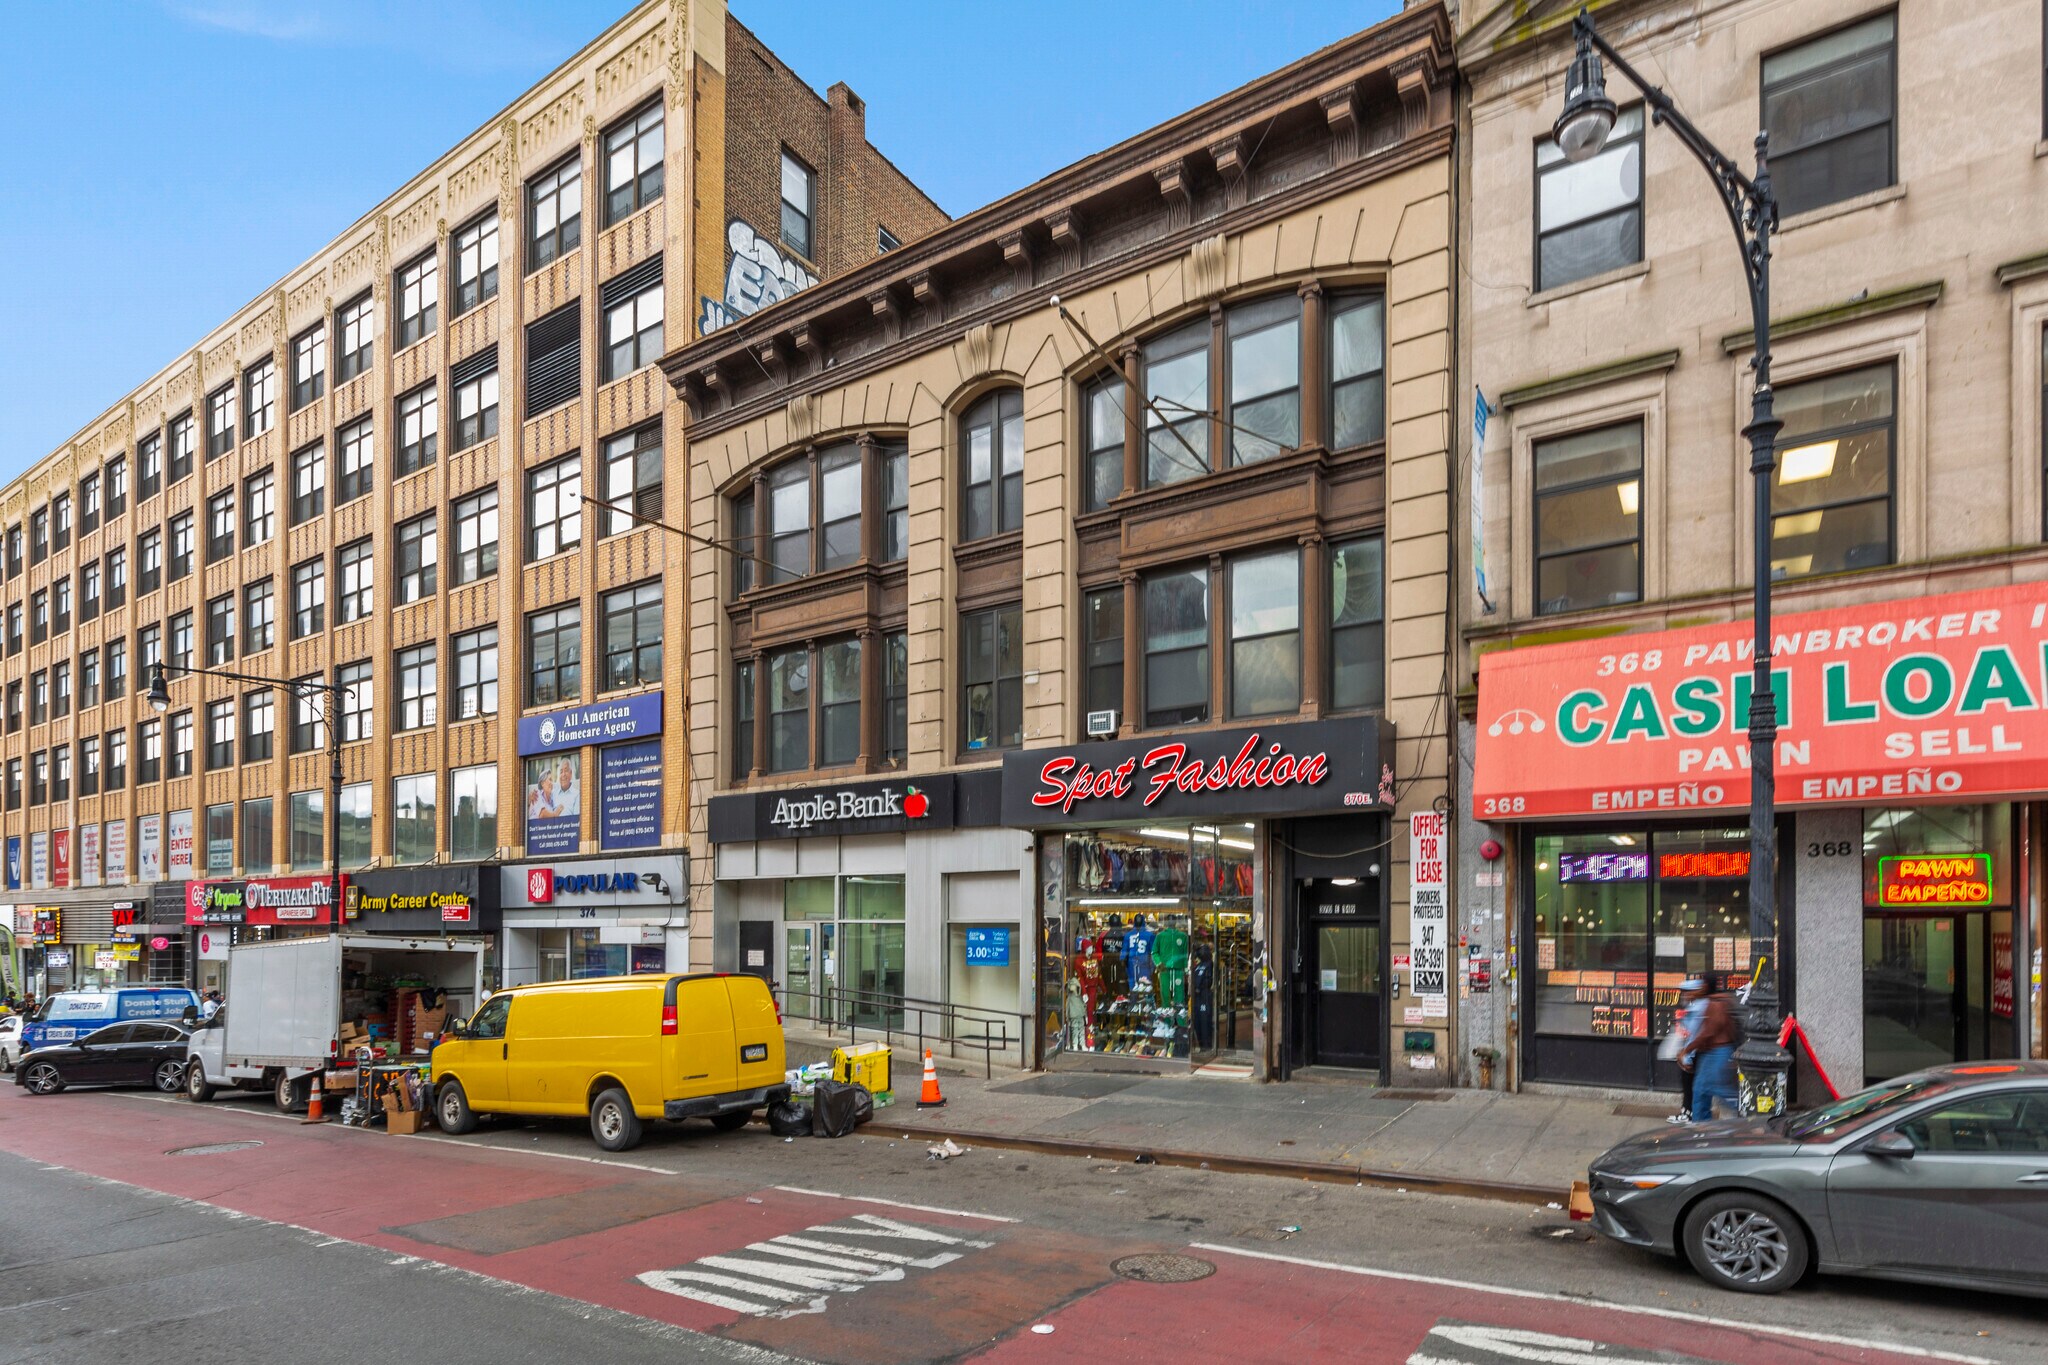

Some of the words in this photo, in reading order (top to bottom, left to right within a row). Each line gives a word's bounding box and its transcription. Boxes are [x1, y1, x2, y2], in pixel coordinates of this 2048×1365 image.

[1596, 649, 1663, 677] 368
[1555, 666, 1793, 748] CASH
[1822, 639, 2048, 728] LOA
[564, 712, 578, 728] All
[581, 706, 630, 725] American
[558, 726, 601, 742] Homecare
[603, 720, 637, 737] Agency
[1884, 725, 2022, 759] SELL
[1032, 755, 1136, 815] Spot
[1141, 733, 1328, 807] Fashion
[1484, 797, 1526, 814] 368
[1591, 782, 1724, 810] EMPEÑO
[1802, 767, 1963, 799] EMPEÑO
[770, 794, 837, 829] Apple
[836, 788, 903, 819] Bank
[1413, 814, 1444, 836] OFFICE
[170, 853, 189, 866] HERE
[1420, 838, 1438, 860] FOR
[1807, 841, 1852, 858] 368
[1416, 861, 1443, 883] LEASE
[1899, 858, 1975, 879] PAWN
[553, 872, 640, 893] POPULAR
[1887, 880, 1988, 901] EMPEÑO
[258, 884, 311, 907] TERIYAKI
[360, 894, 388, 913] Army
[390, 893, 428, 909] Career
[430, 891, 469, 908] Center
[1416, 890, 1441, 904] BROKERS
[111, 909, 135, 926] TAX
[580, 907, 596, 918] 374
[1413, 905, 1444, 919] PROTECTED
[1421, 925, 1434, 946] 347
[967, 946, 987, 958] 3.00
[1414, 948, 1444, 969] 926-3391
[1415, 971, 1442, 986] RW
[124, 999, 161, 1007] Donate
[163, 997, 189, 1006] Stuff
[127, 1009, 161, 1017] Create
